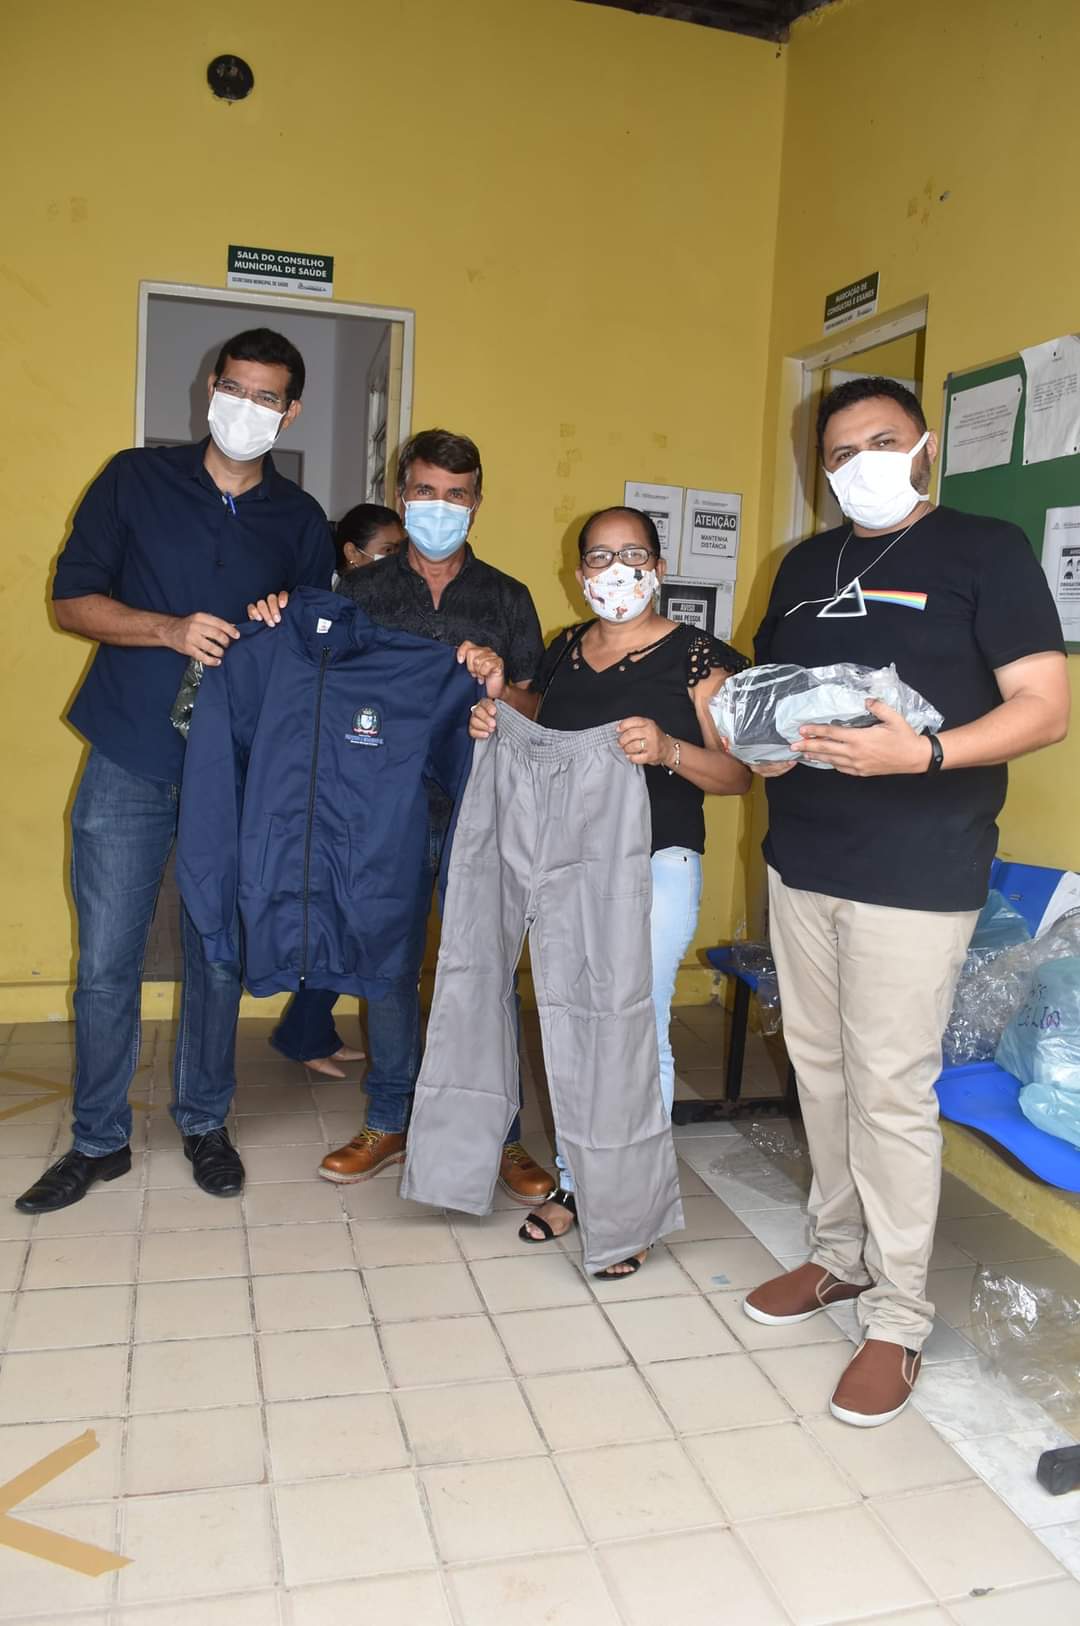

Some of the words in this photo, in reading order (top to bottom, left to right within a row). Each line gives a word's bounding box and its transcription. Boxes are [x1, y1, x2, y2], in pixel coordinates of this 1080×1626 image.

[237, 250, 259, 260] SALA
[261, 253, 275, 262] DO
[277, 255, 325, 268] CONSELHO
[234, 260, 283, 273] MUNICIPAL
[285, 266, 297, 274] DE
[298, 266, 327, 278] SAÚDE
[695, 514, 736, 529] ATENÇÃO
[700, 541, 727, 550] DISTÂNCIA
[701, 534, 728, 543] MANTENHA
